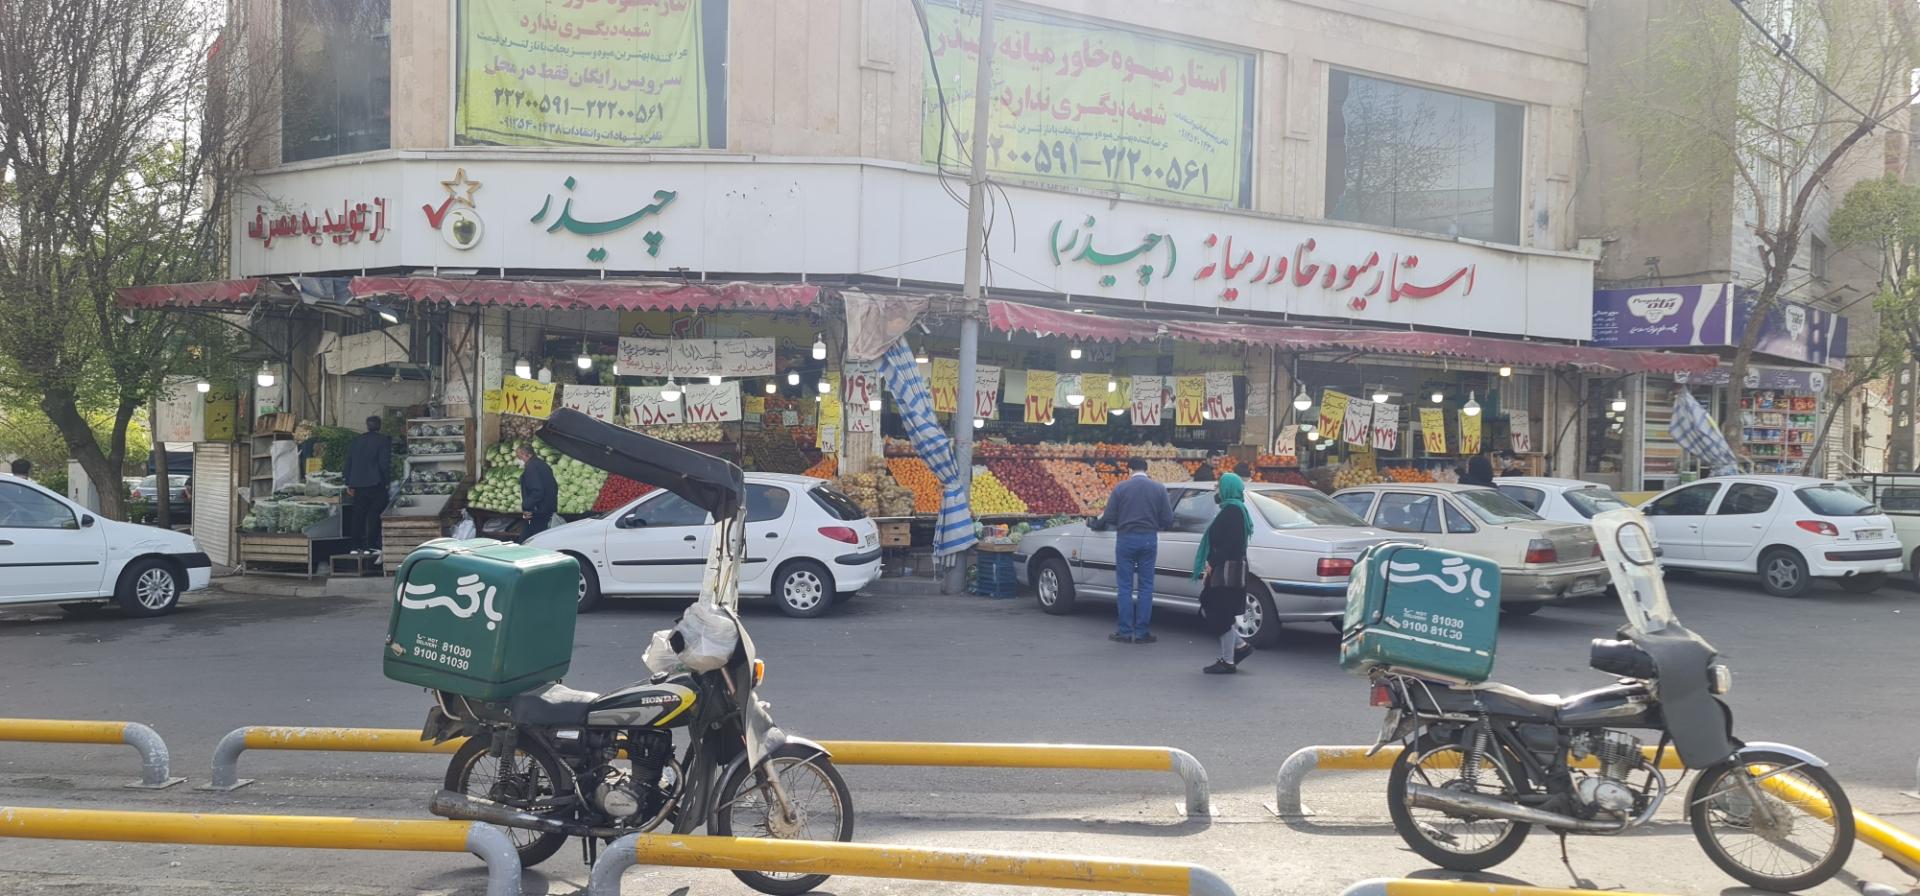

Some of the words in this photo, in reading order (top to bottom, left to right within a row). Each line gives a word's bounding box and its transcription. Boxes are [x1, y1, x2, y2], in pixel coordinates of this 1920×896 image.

[247, 204, 300, 249] مصرف
[301, 210, 320, 246] به
[322, 199, 367, 244] تولید
[369, 196, 386, 242] از
[530, 175, 678, 263] چیذر
[1193, 232, 1256, 301] میانه
[1250, 237, 1321, 288] خاور
[1321, 250, 1381, 311] میوه
[1364, 252, 1477, 304] استار
[397, 573, 503, 631] باگت
[1380, 557, 1491, 608] باگت
[1401, 619, 1428, 633] 9100
[1431, 614, 1464, 630] 81030
[413, 646, 438, 661] 9100
[439, 653, 469, 671] 81030
[441, 641, 472, 659] 81030
[641, 694, 680, 704] HONDA
